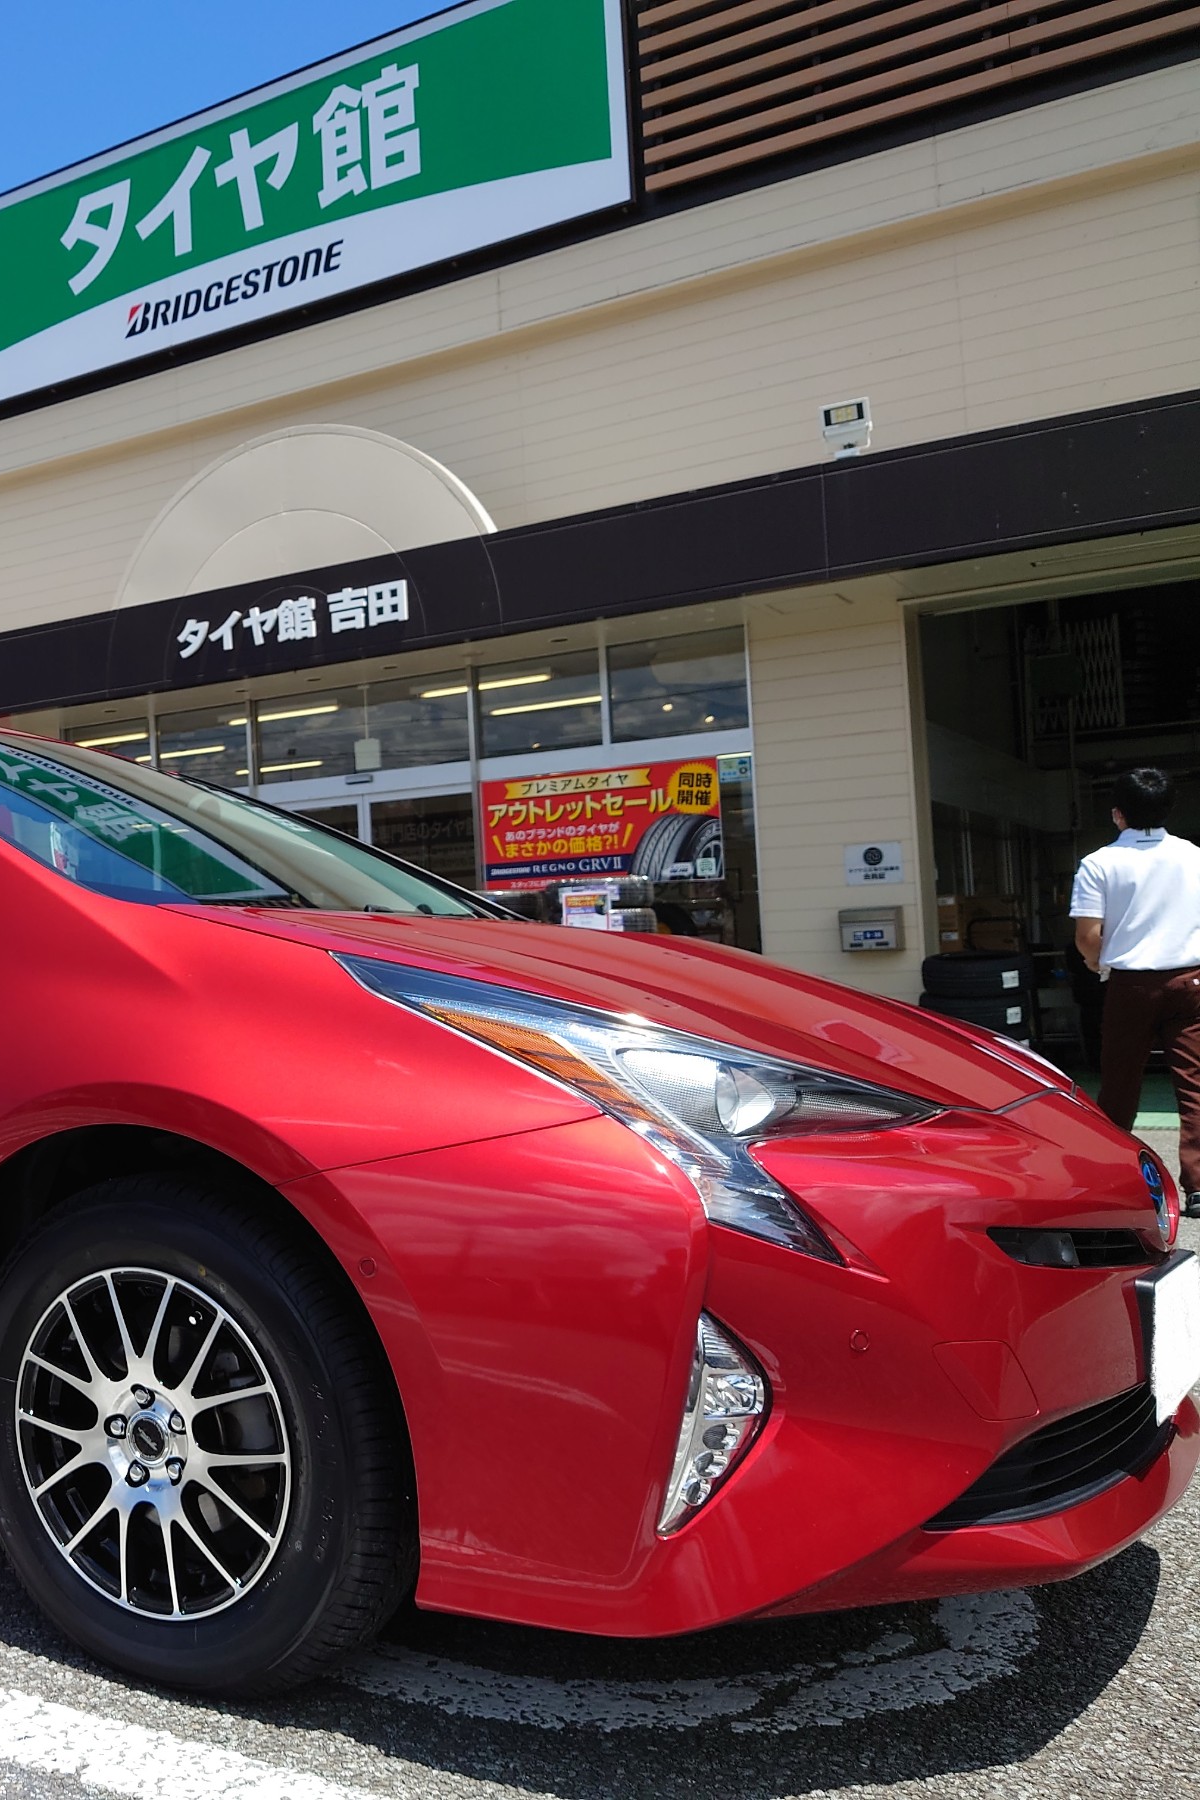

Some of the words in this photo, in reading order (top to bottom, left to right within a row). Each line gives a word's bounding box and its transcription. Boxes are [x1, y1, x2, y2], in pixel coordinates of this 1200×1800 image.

[60, 63, 421, 295] タイヤ館
[125, 239, 344, 339] BRIDGESTONE
[177, 597, 317, 659] タイヤ館
[327, 579, 409, 634] 吉田
[520, 773, 630, 796] プレミアムタイヤ
[677, 772, 712, 788] 同時
[488, 788, 674, 828] アウトレットセール
[676, 788, 712, 806] 開催
[504, 821, 620, 842] あのブランドのタイヤが
[532, 862, 576, 873] REGNO
